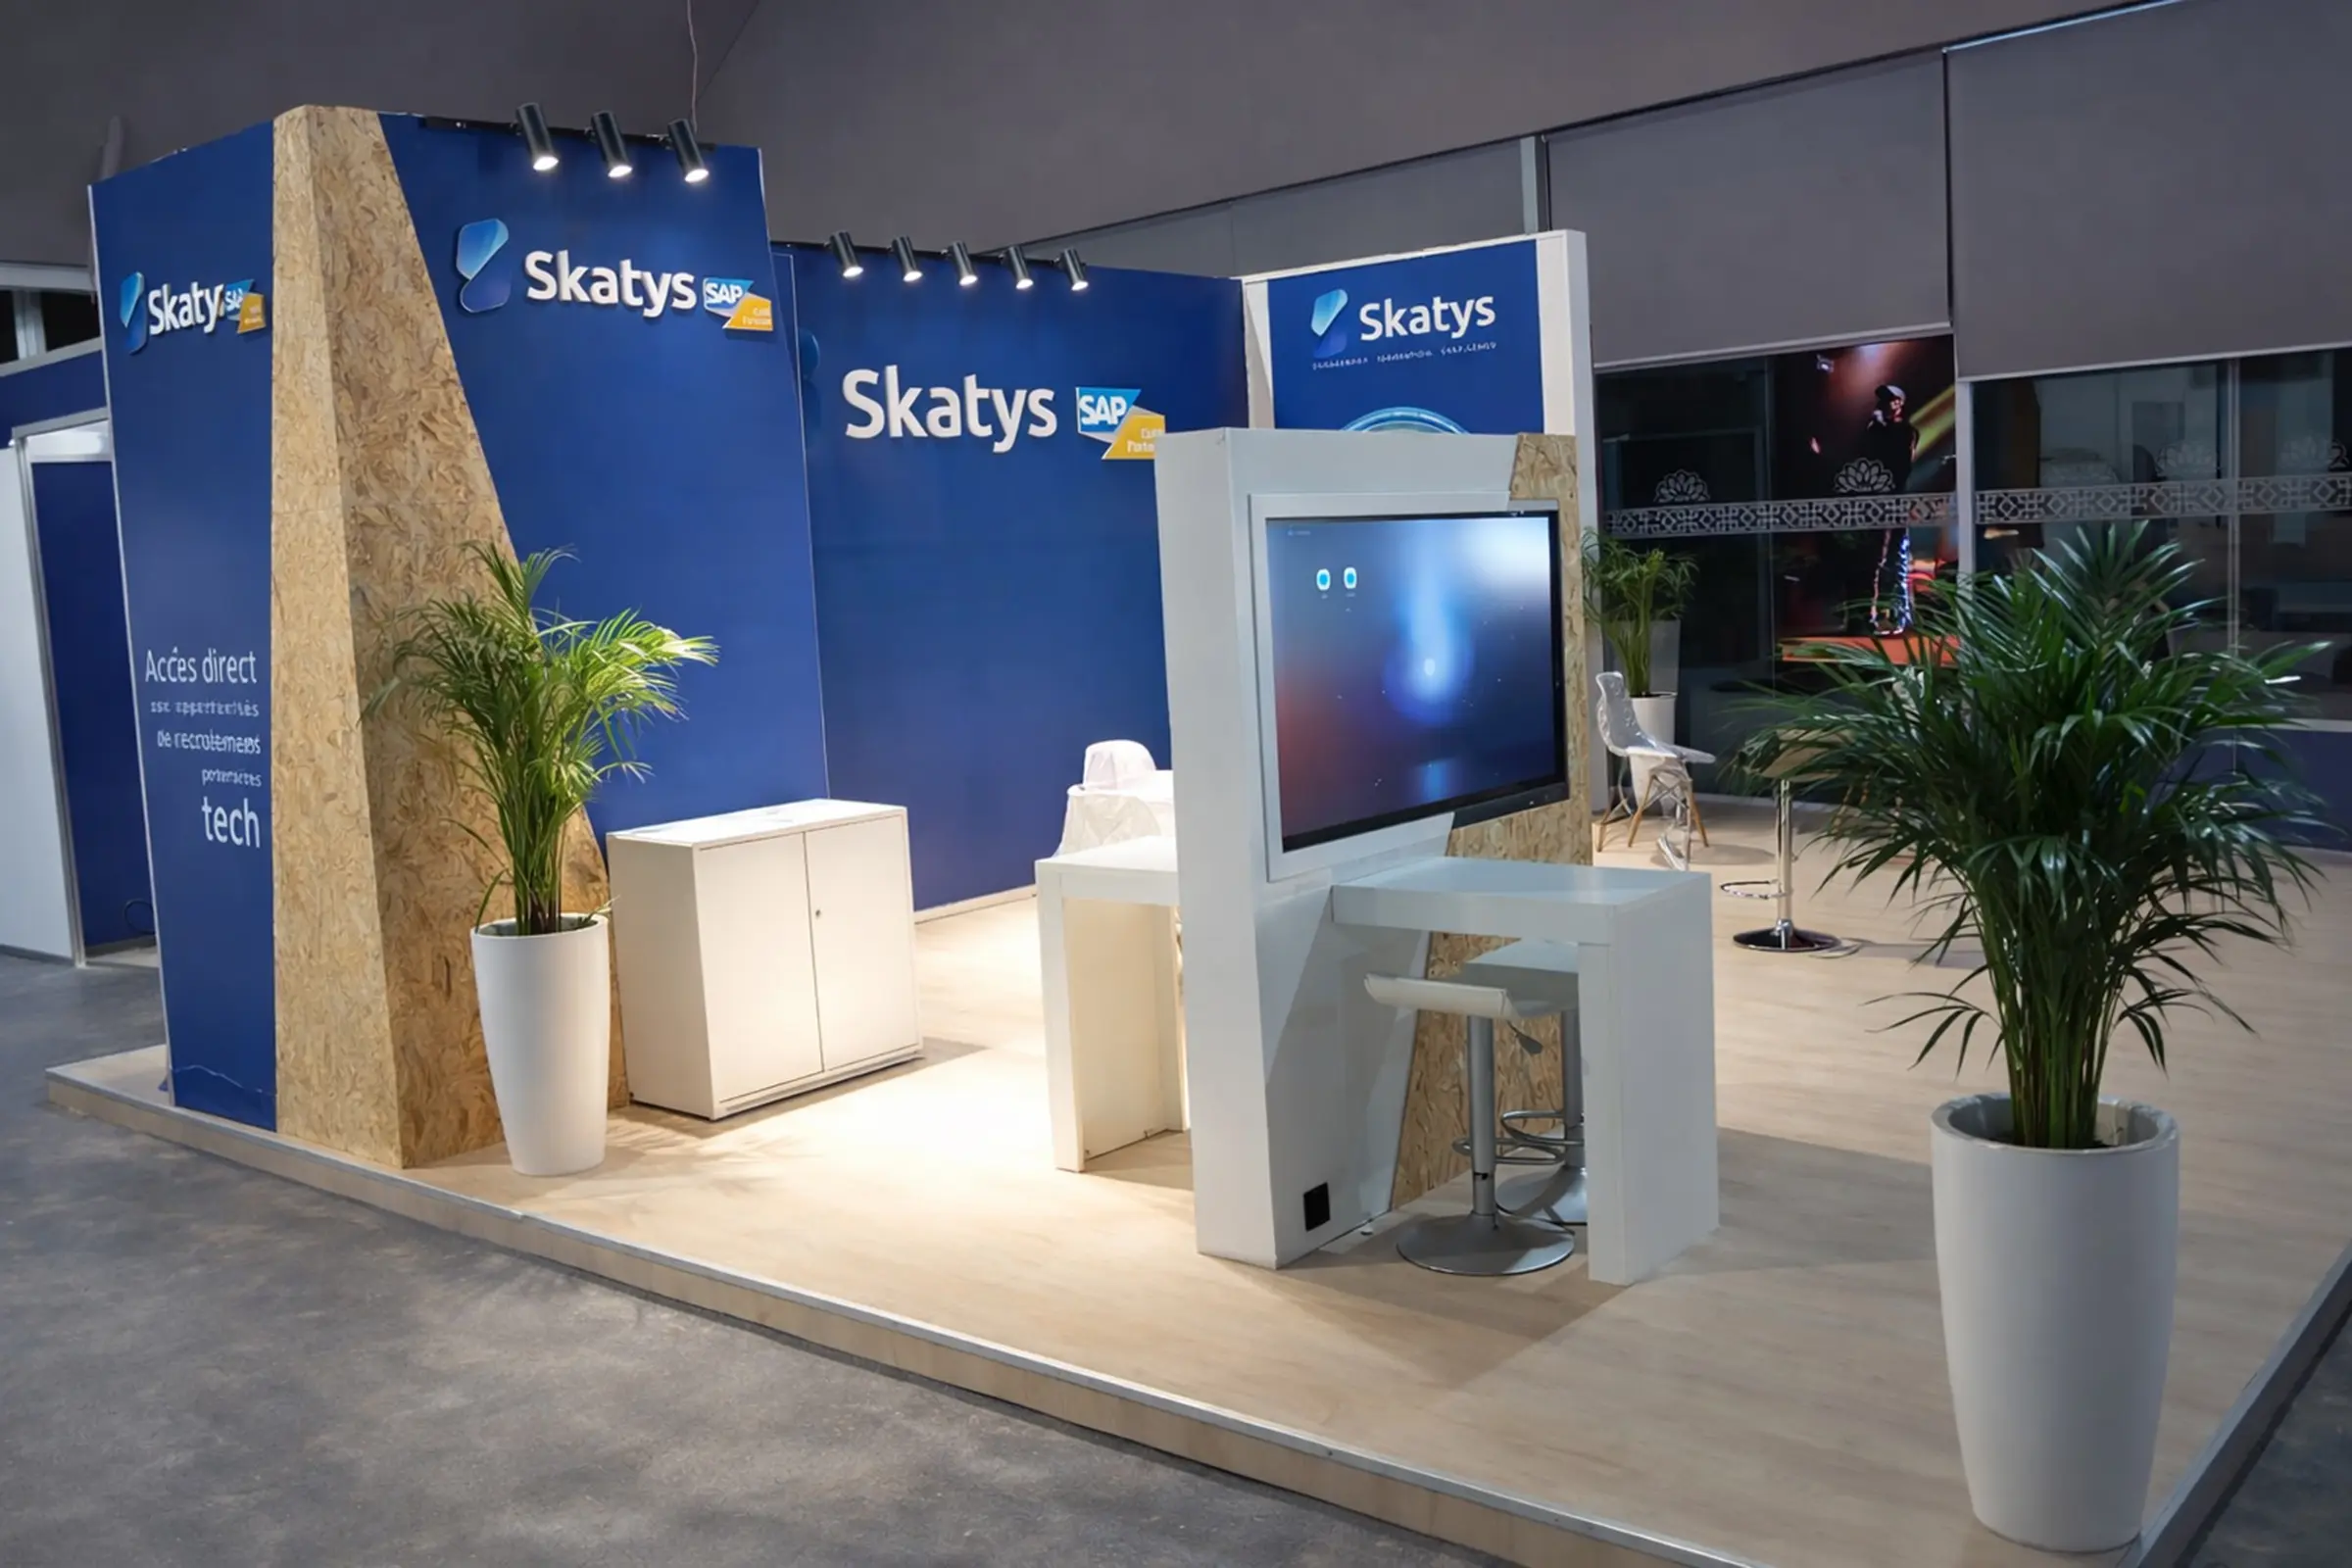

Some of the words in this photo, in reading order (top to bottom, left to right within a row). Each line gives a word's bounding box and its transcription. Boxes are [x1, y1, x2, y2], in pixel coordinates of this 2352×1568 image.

[524, 249, 697, 318] Skatys
[706, 282, 743, 305] SAP
[1359, 296, 1496, 341] Skatys
[842, 364, 1057, 454] Skatys
[1079, 394, 1127, 425] SAP
[202, 647, 258, 684] direct
[201, 796, 261, 849] tech
